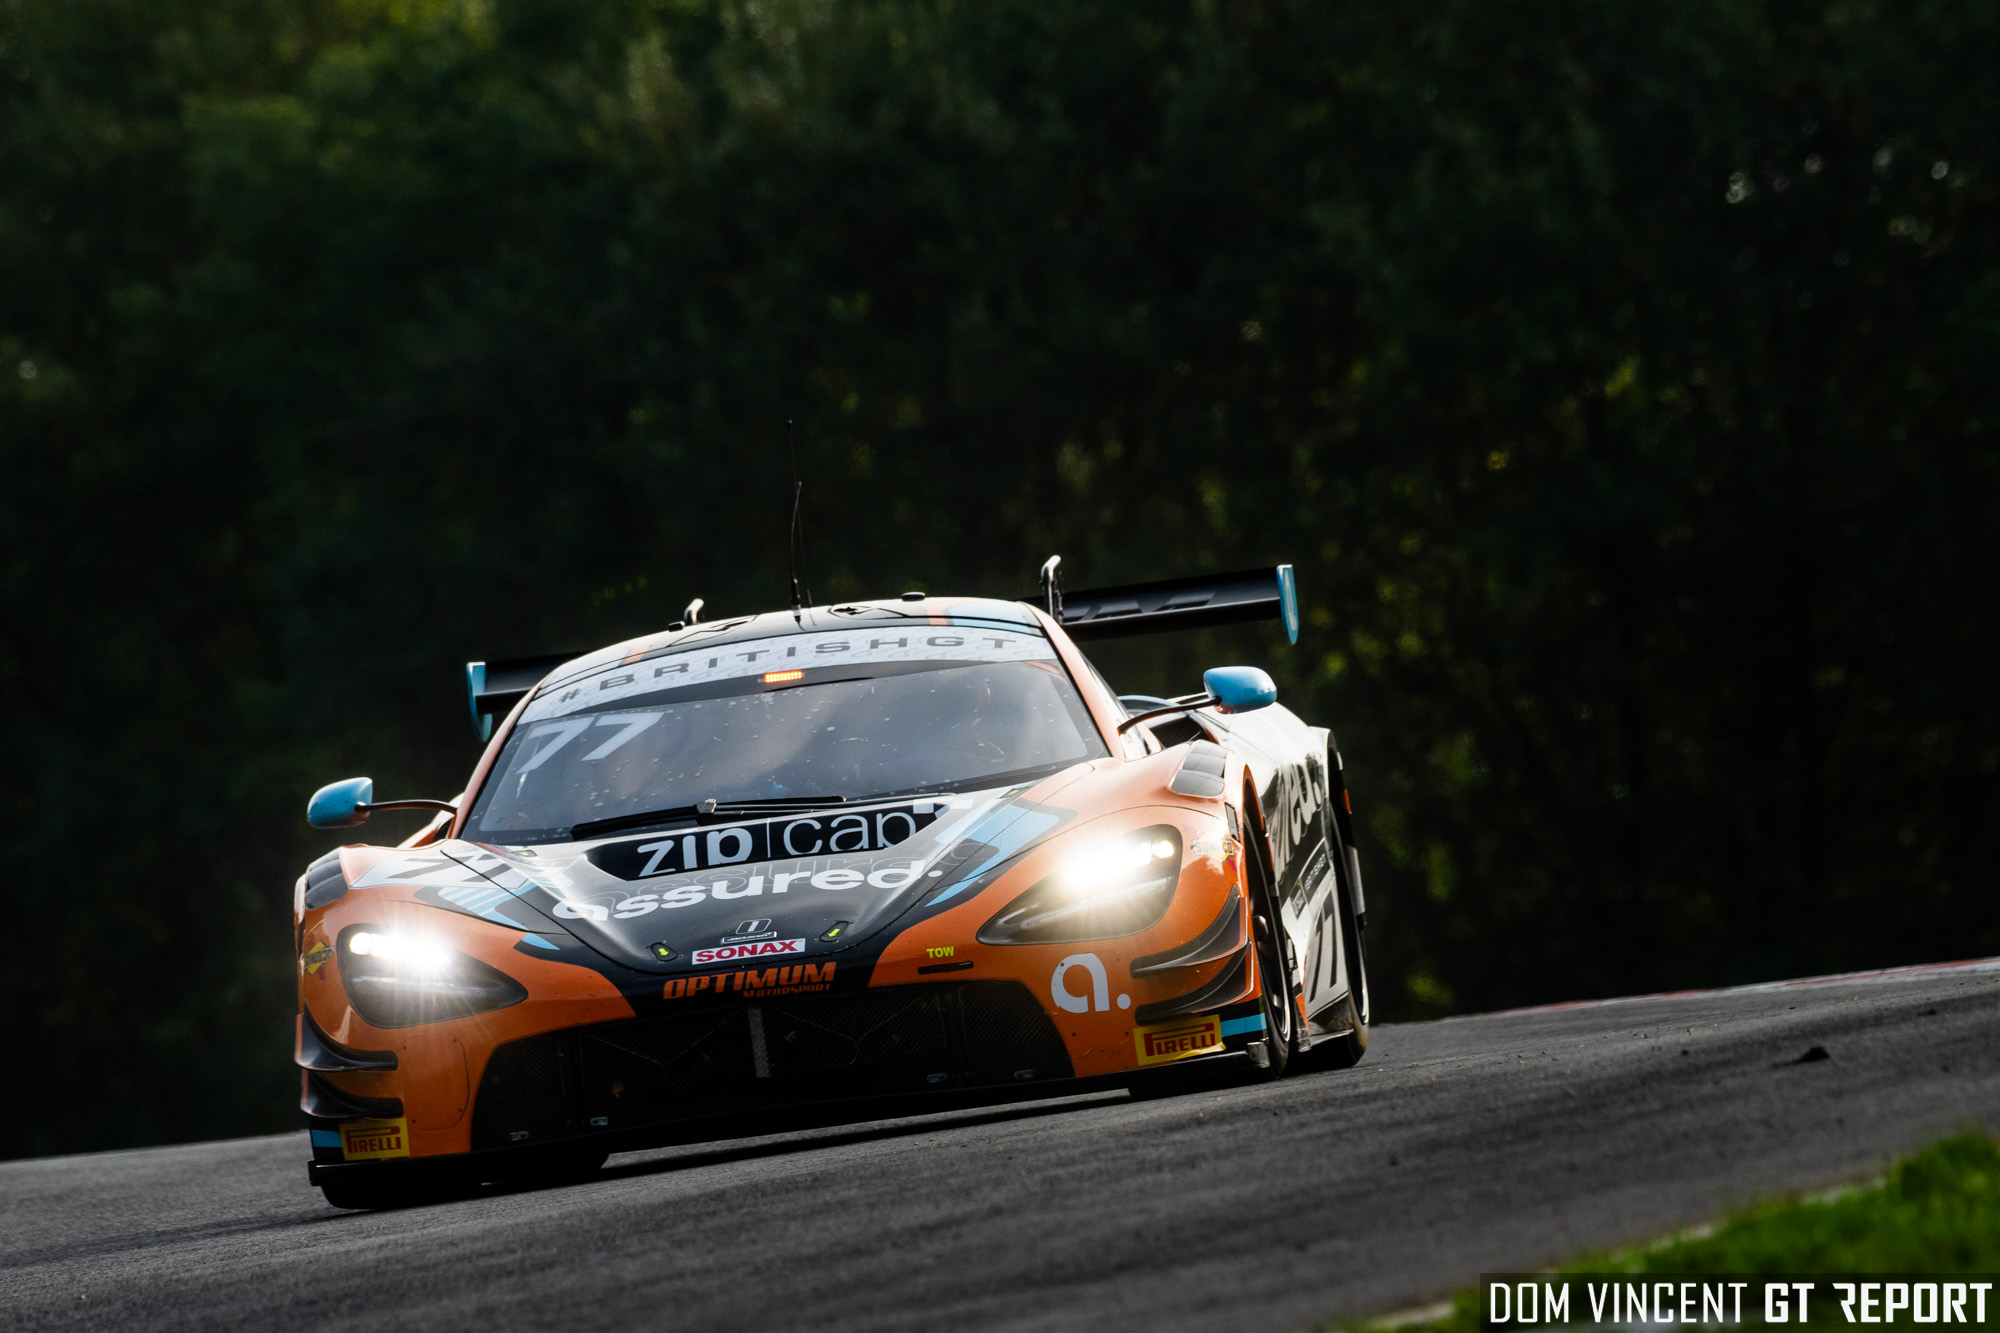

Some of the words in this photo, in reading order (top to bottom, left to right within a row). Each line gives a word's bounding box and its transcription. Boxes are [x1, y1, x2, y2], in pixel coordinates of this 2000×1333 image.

[516, 712, 665, 774] 77
[696, 940, 799, 963] SONAX
[926, 946, 954, 958] TOW
[663, 961, 837, 999] OPTIMUM
[1143, 1022, 1216, 1057] PIRELLI
[344, 1126, 402, 1153] PIRELLI
